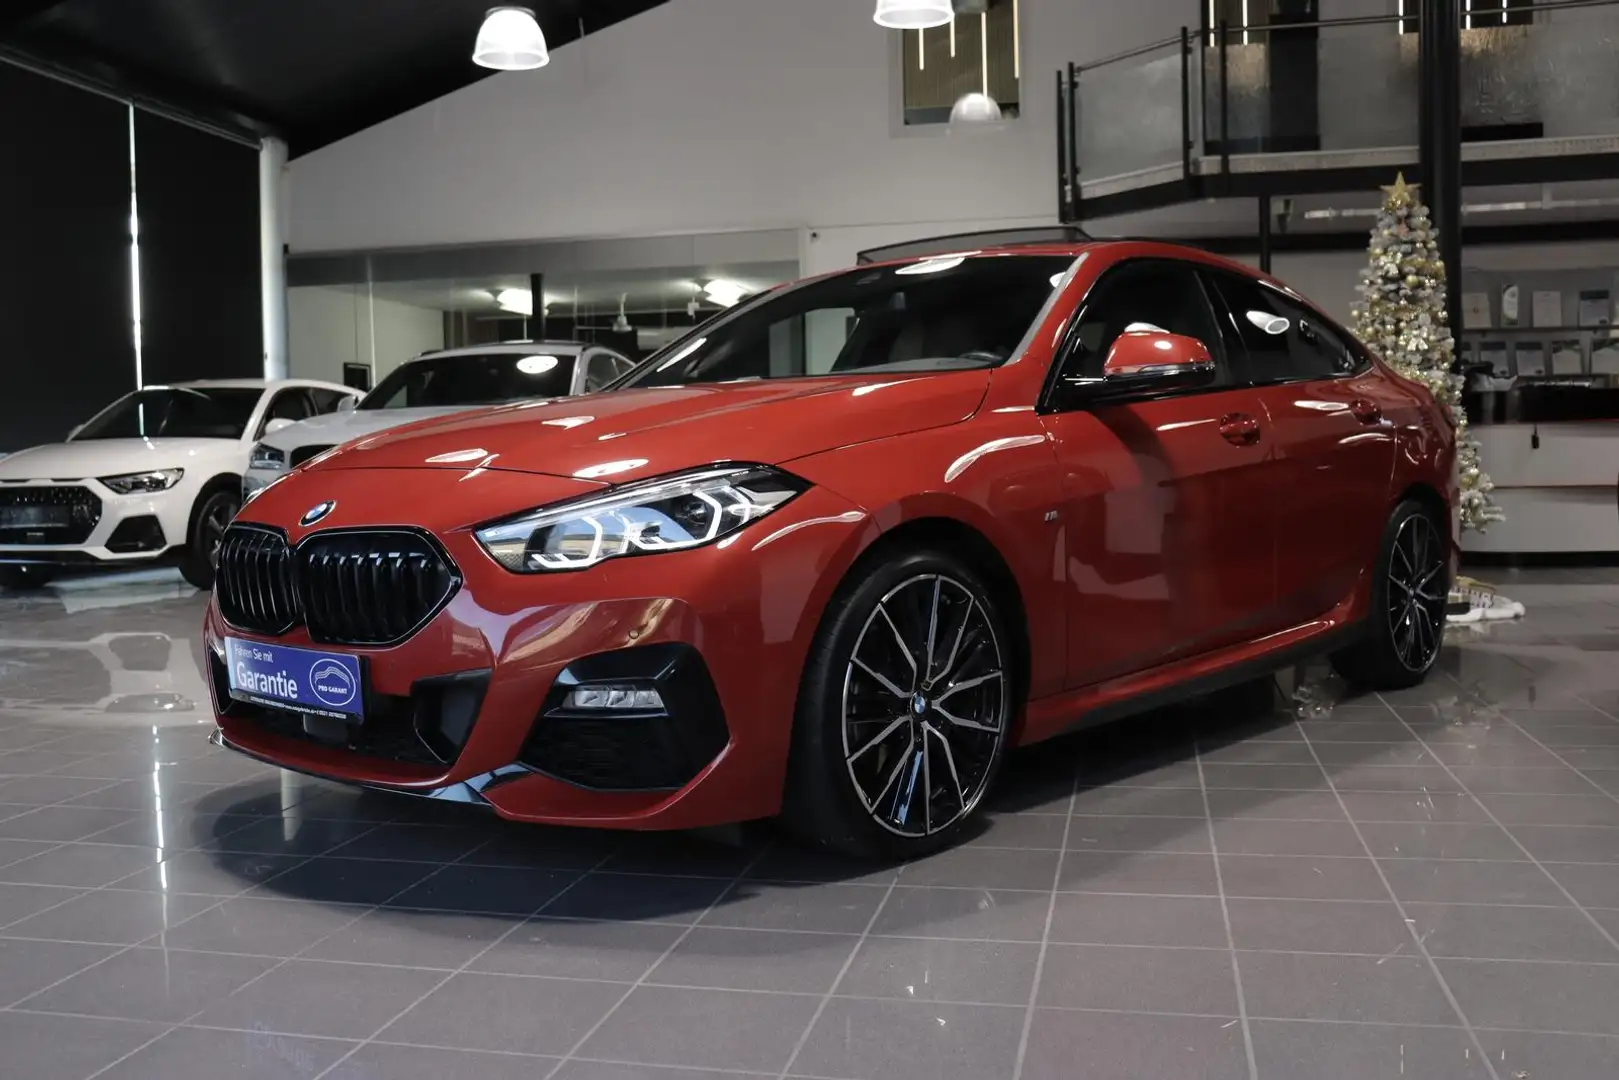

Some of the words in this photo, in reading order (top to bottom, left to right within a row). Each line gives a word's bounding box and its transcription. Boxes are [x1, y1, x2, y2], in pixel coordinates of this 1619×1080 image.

[253, 648, 262, 661] Sie
[263, 650, 274, 663] mit
[236, 661, 299, 699] Garantie
